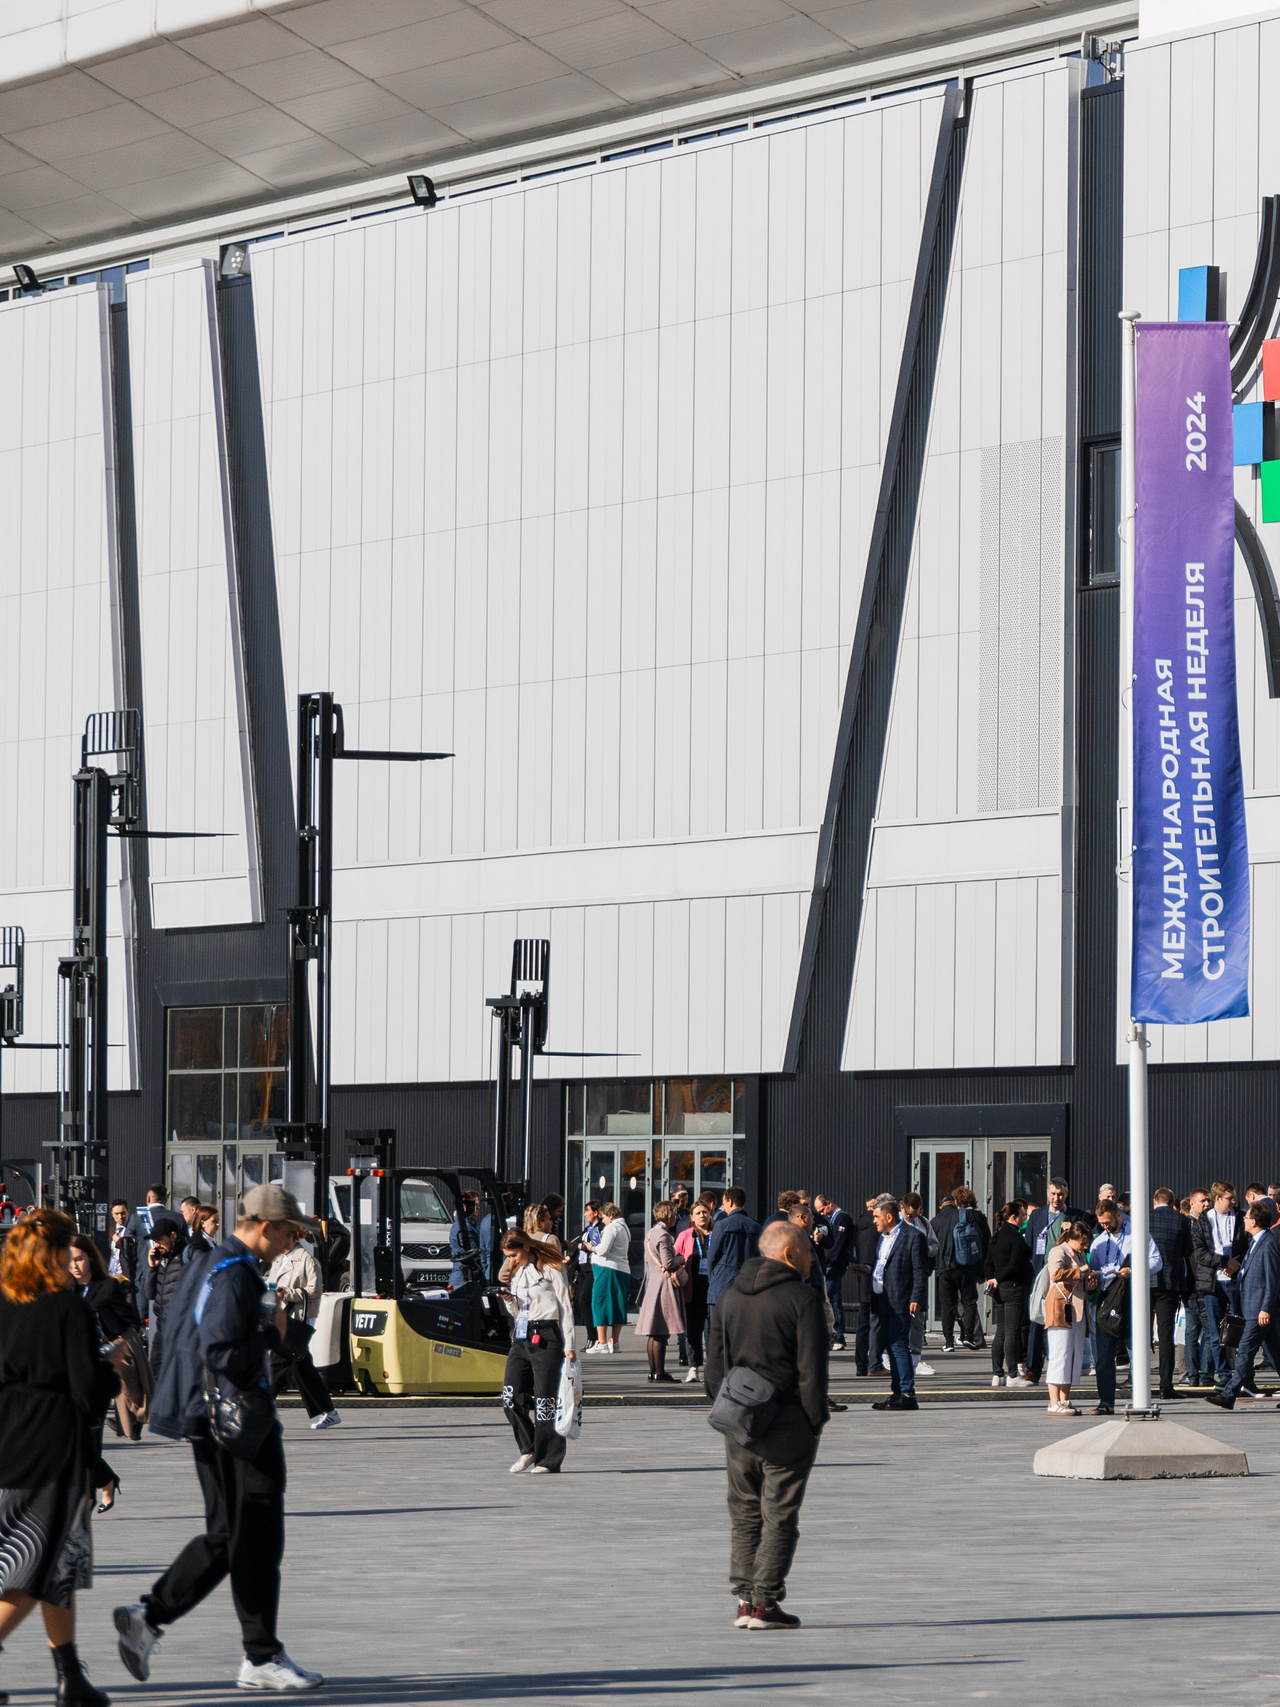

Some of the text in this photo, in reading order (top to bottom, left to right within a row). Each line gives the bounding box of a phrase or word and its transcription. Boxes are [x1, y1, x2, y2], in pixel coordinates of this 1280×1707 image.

[1186, 392, 1207, 471] 2024
[1155, 658, 1188, 979] МЕЖДУНАРОДНАЯ
[1185, 562, 1225, 981] СТРОИТЕЛЬНАЯ НЕДЕЛЯ
[355, 1313, 377, 1329] YETT
